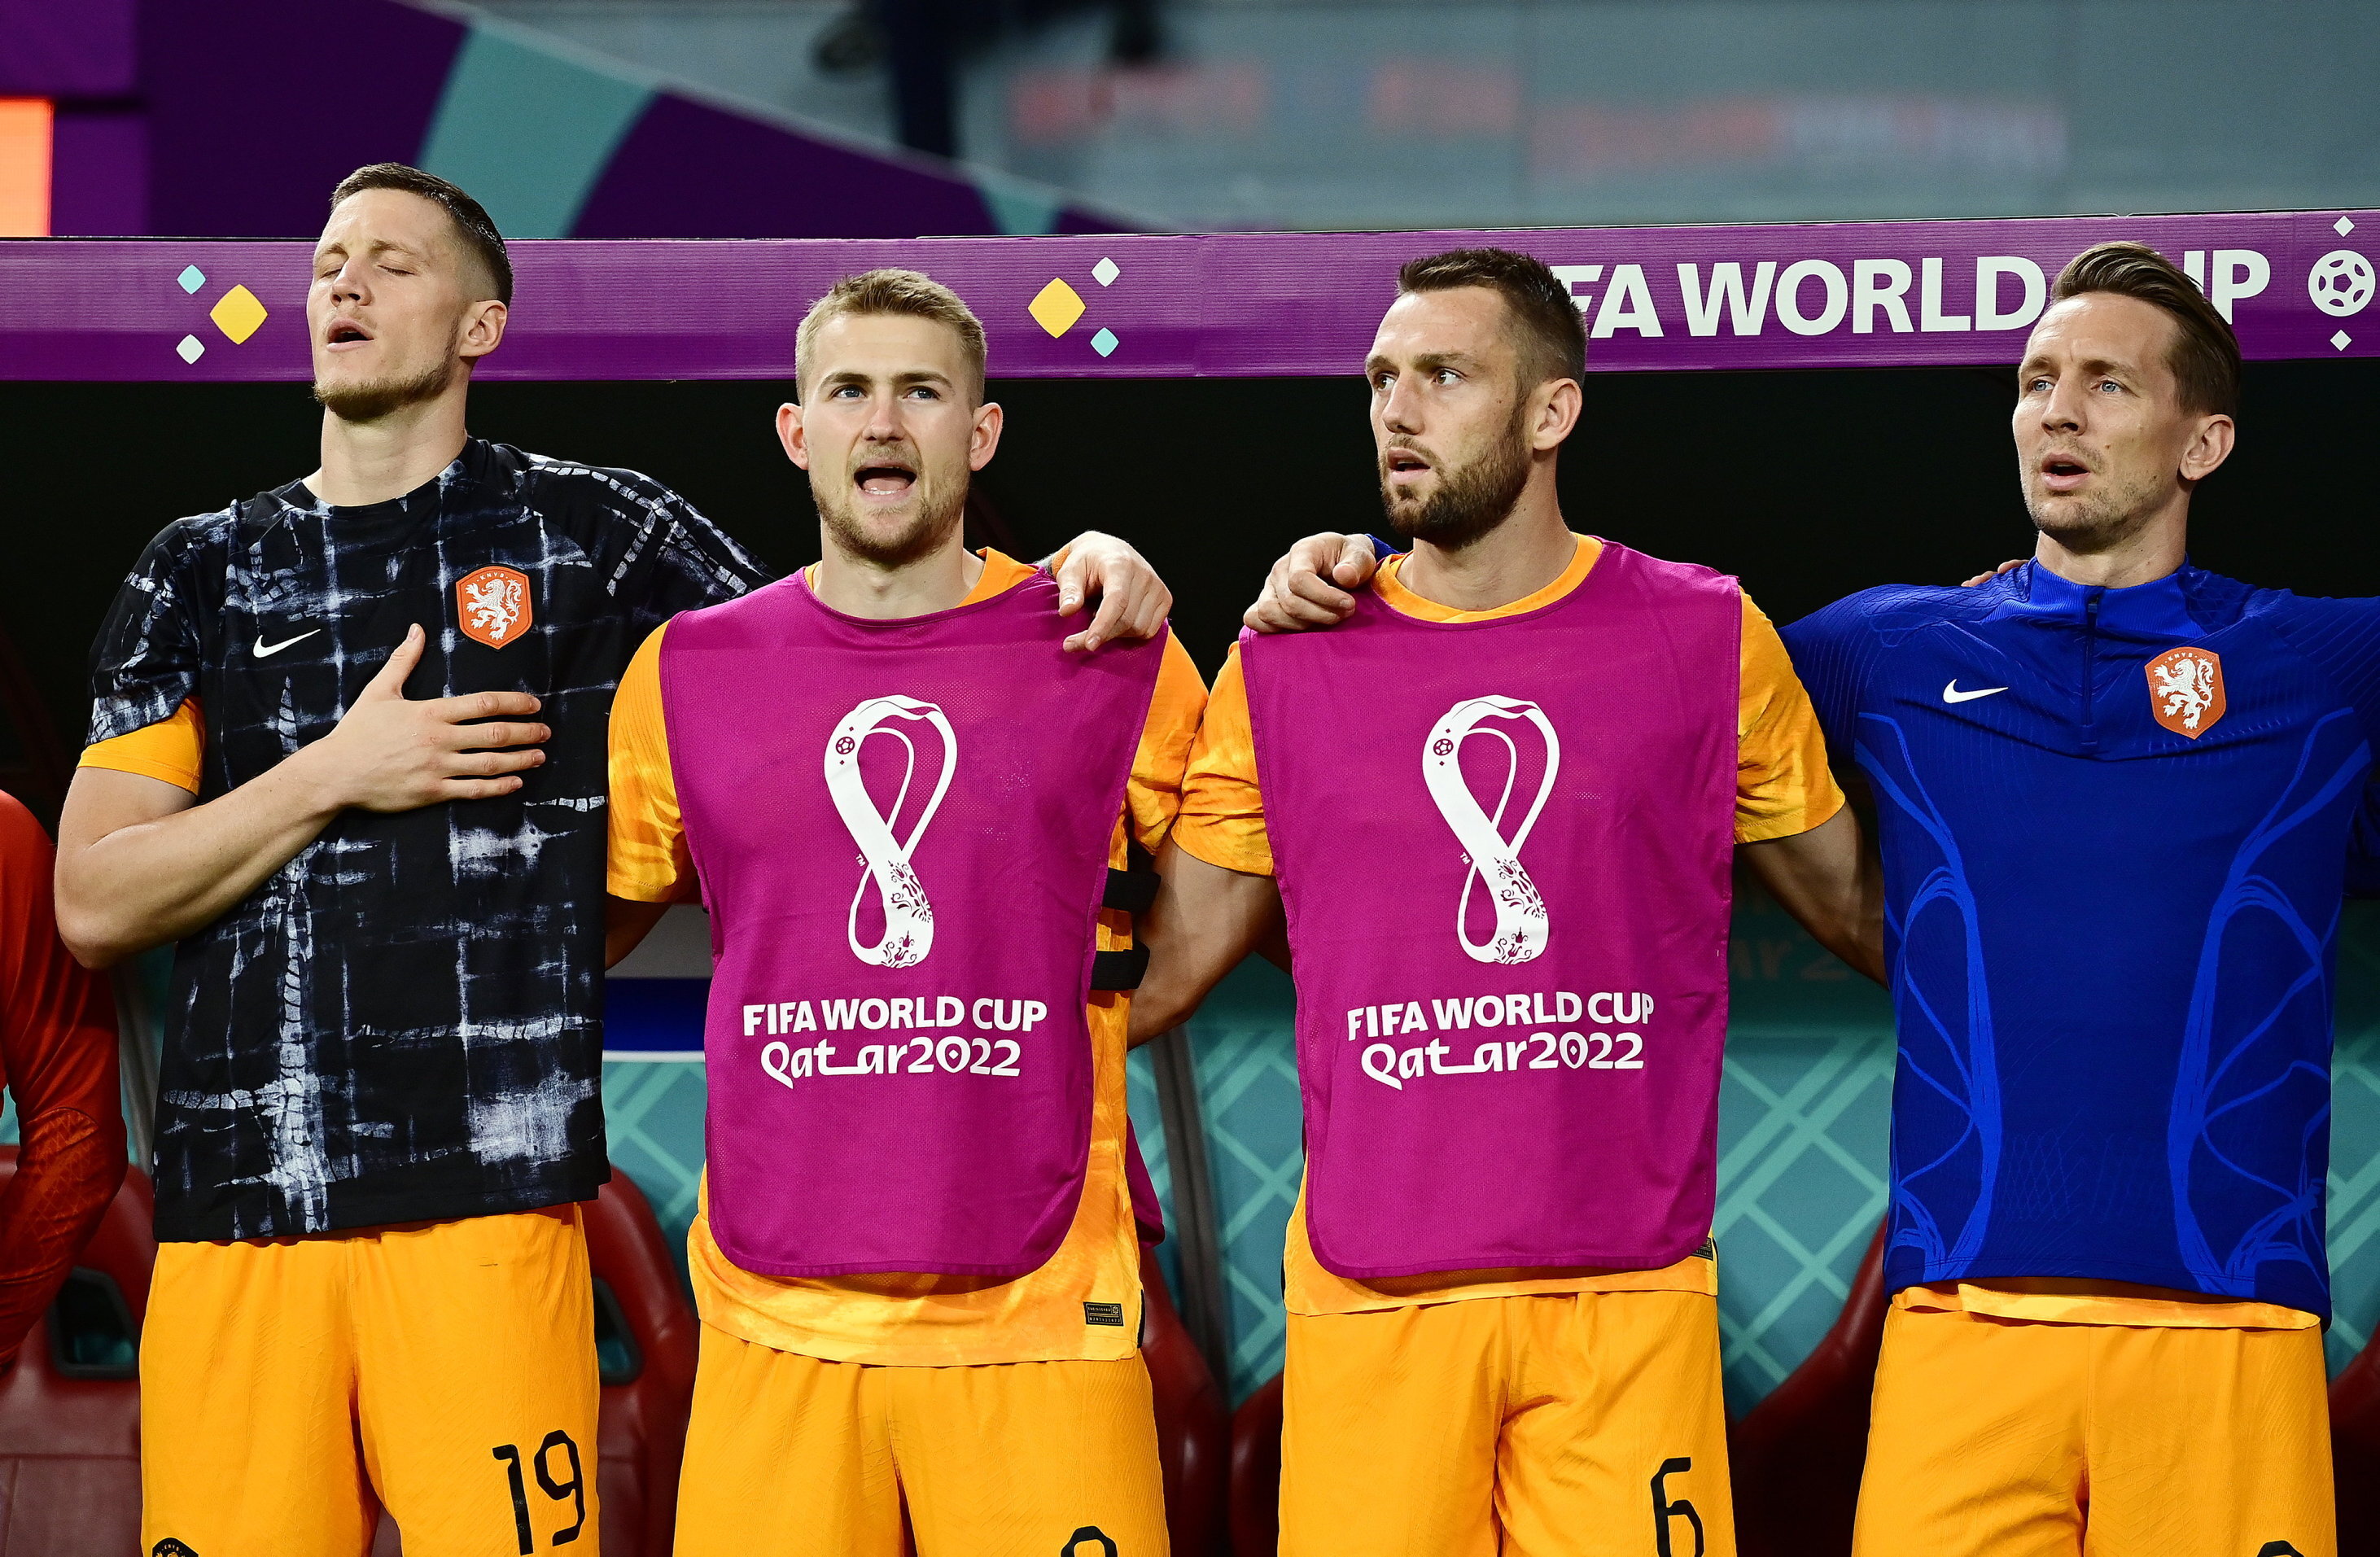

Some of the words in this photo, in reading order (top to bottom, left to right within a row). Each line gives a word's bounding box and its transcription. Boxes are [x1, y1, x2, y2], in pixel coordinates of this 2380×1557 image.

[1549, 264, 1665, 339] FA
[1676, 256, 2047, 337] WORLD
[742, 1000, 818, 1036] FIFA
[820, 995, 965, 1030] WORLD
[972, 997, 1048, 1032] CUP
[1347, 1000, 1429, 1042] FIFA
[1431, 991, 1583, 1030] WORLD
[1587, 991, 1655, 1025] CUP
[760, 1035, 1022, 1091] Qatar2022
[1361, 1031, 1645, 1091] Qatar2022
[492, 1429, 586, 1556] 19
[1650, 1456, 1705, 1557] 6
